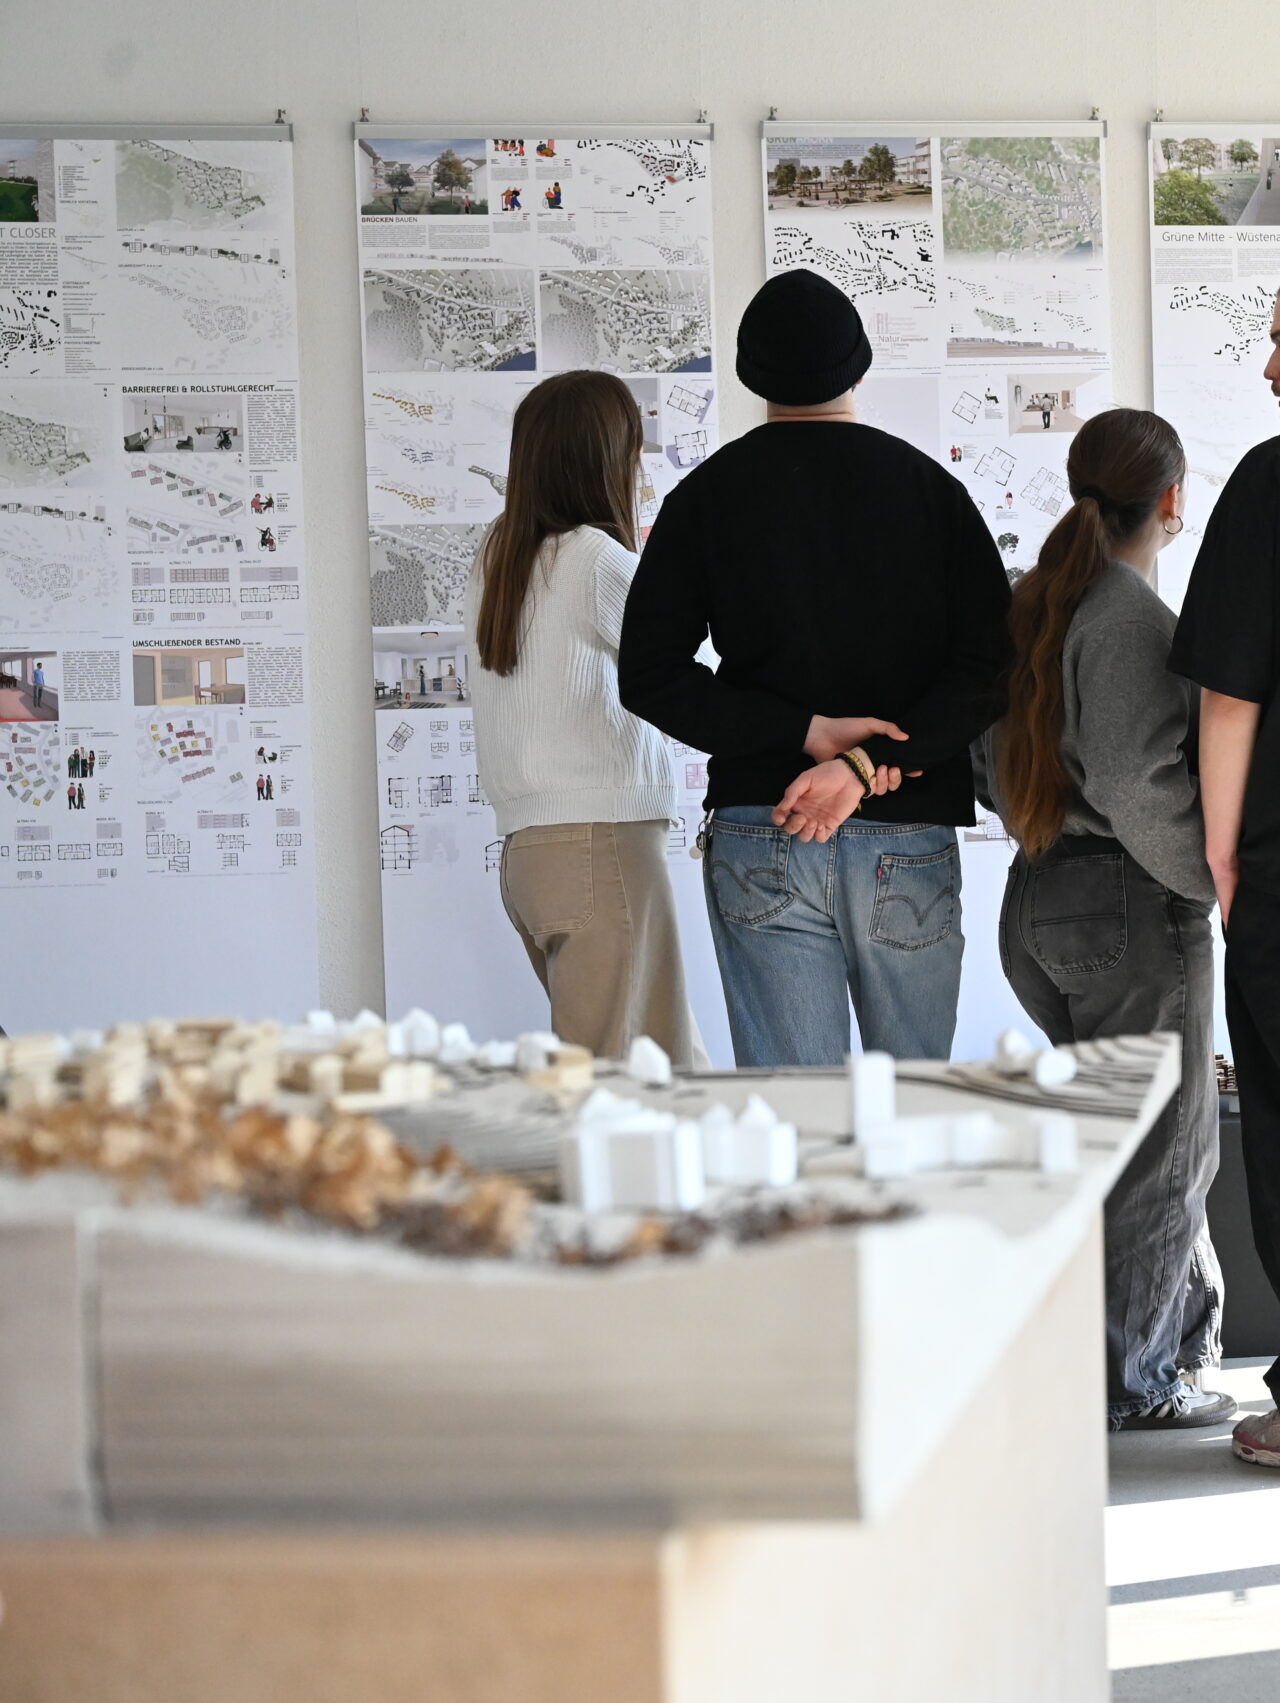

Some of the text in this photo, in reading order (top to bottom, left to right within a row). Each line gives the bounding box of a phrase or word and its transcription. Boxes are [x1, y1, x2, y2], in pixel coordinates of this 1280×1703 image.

[9, 227, 57, 239] CLOSER
[1162, 231, 1195, 242] Grüne
[1198, 231, 1225, 242] Mitte
[122, 385, 179, 394] BARRIEREFREI
[190, 384, 275, 393] ROLLSTUHLGERECHT
[132, 639, 203, 648] UMSCHLIEßENDER
[205, 638, 241, 646] BESTAND
